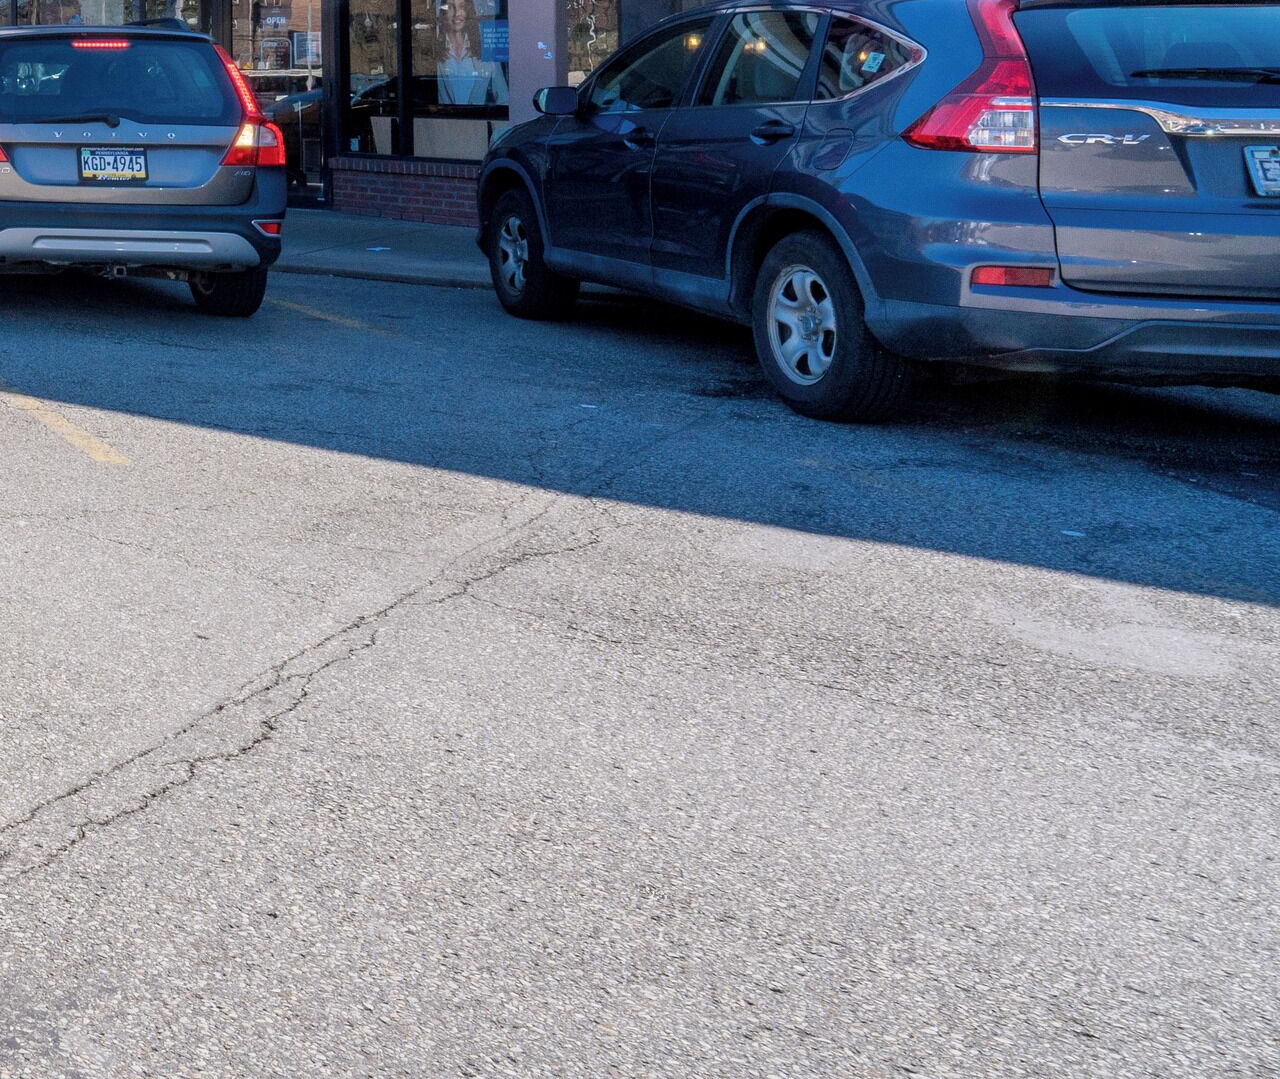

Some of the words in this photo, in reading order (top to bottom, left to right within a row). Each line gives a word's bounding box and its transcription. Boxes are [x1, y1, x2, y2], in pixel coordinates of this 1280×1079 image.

[266, 16, 286, 24] OPEN
[53, 131, 177, 140] VOLVO
[1057, 133, 1151, 145] CR-V
